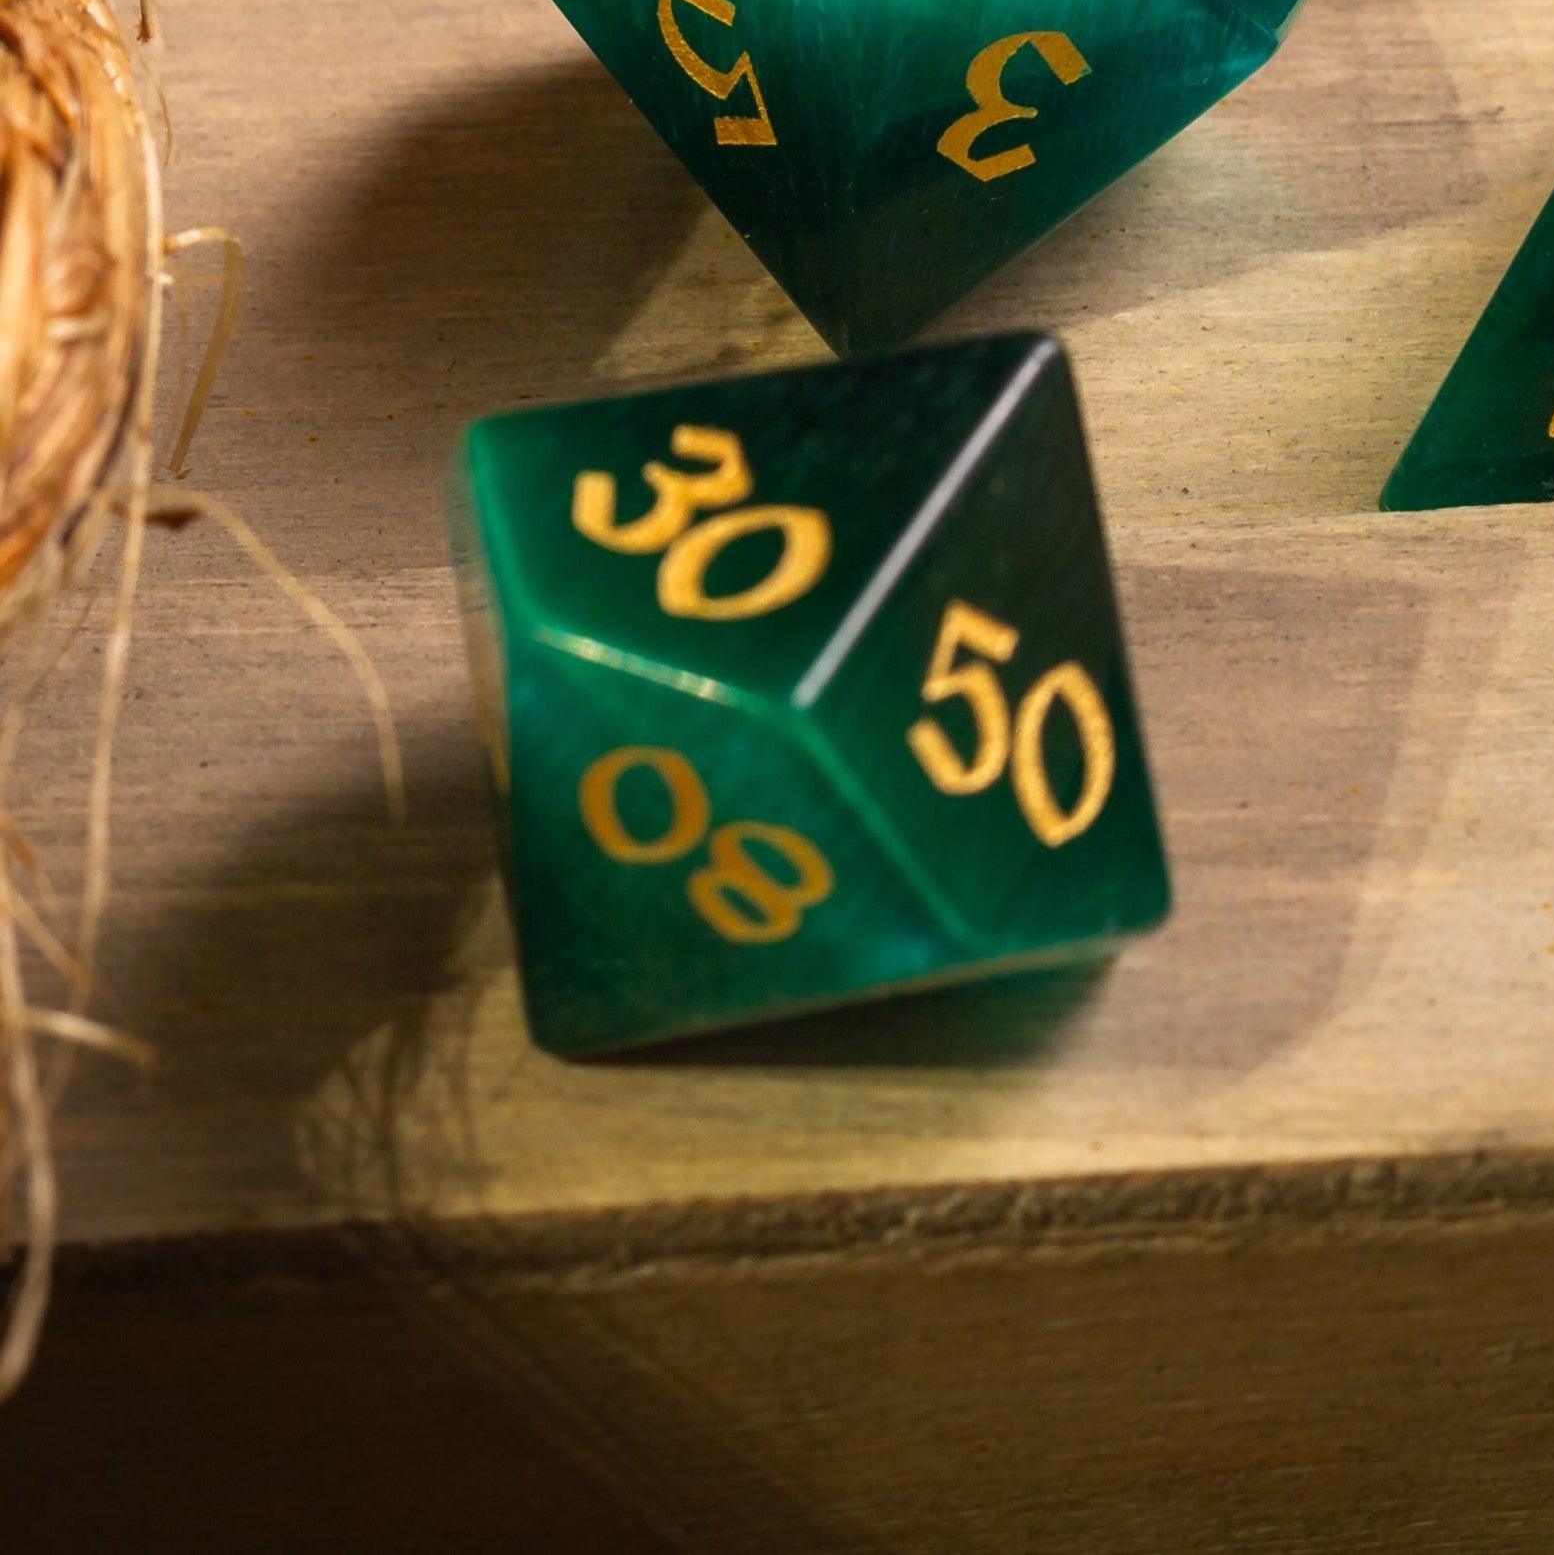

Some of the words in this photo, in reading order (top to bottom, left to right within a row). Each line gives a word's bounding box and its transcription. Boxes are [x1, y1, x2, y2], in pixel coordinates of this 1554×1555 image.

[935, 30, 1093, 184] 3
[572, 424, 833, 620] 30
[908, 600, 1117, 847] 50
[578, 745, 834, 944] 80
